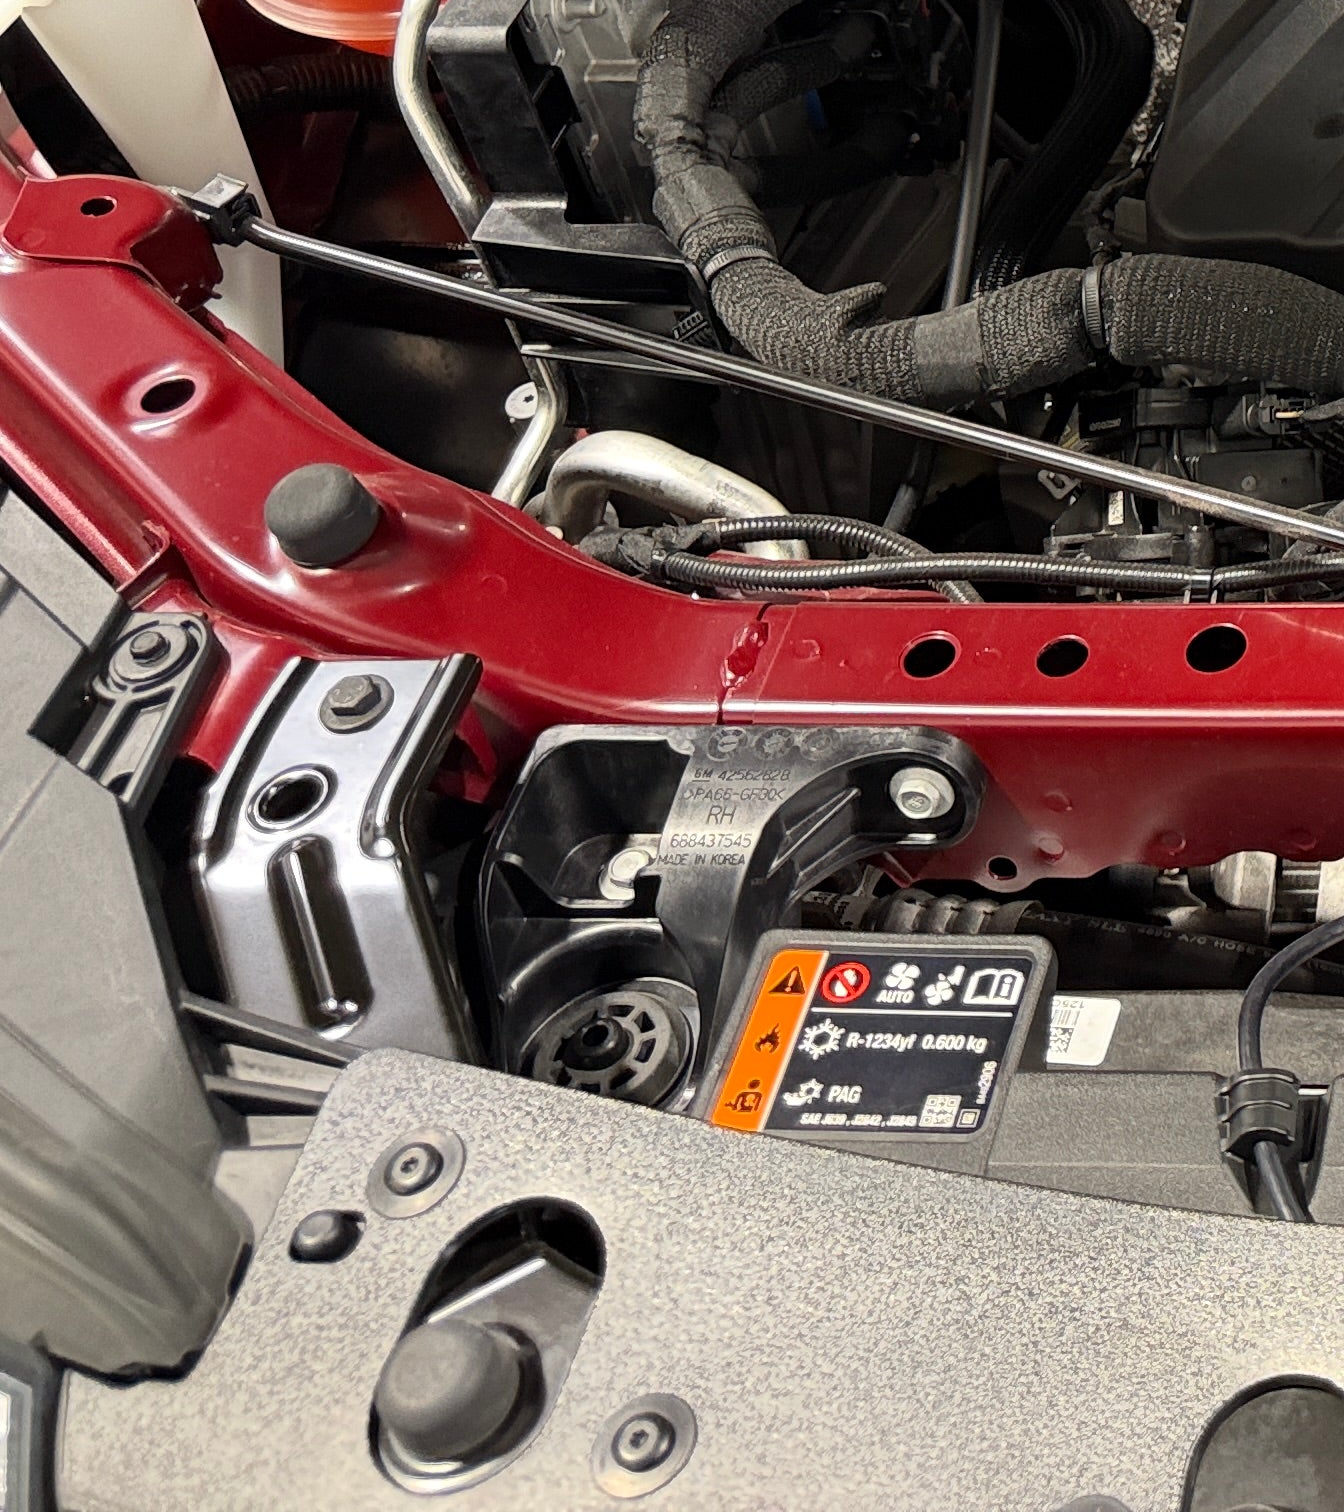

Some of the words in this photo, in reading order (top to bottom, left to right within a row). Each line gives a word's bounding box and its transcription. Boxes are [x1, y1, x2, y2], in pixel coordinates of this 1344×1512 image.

[706, 805, 737, 825] RH
[670, 833, 753, 848] 688437545
[657, 854, 688, 865] MADE
[694, 854, 707, 865] IN
[710, 854, 746, 865] KOREA
[875, 990, 915, 1003] AUTO
[846, 1032, 917, 1052] R-1234yf
[922, 1034, 964, 1050] 0.600
[966, 1035, 988, 1053] kg
[828, 1085, 863, 1103] PAG
[800, 1113, 822, 1125] SAE
